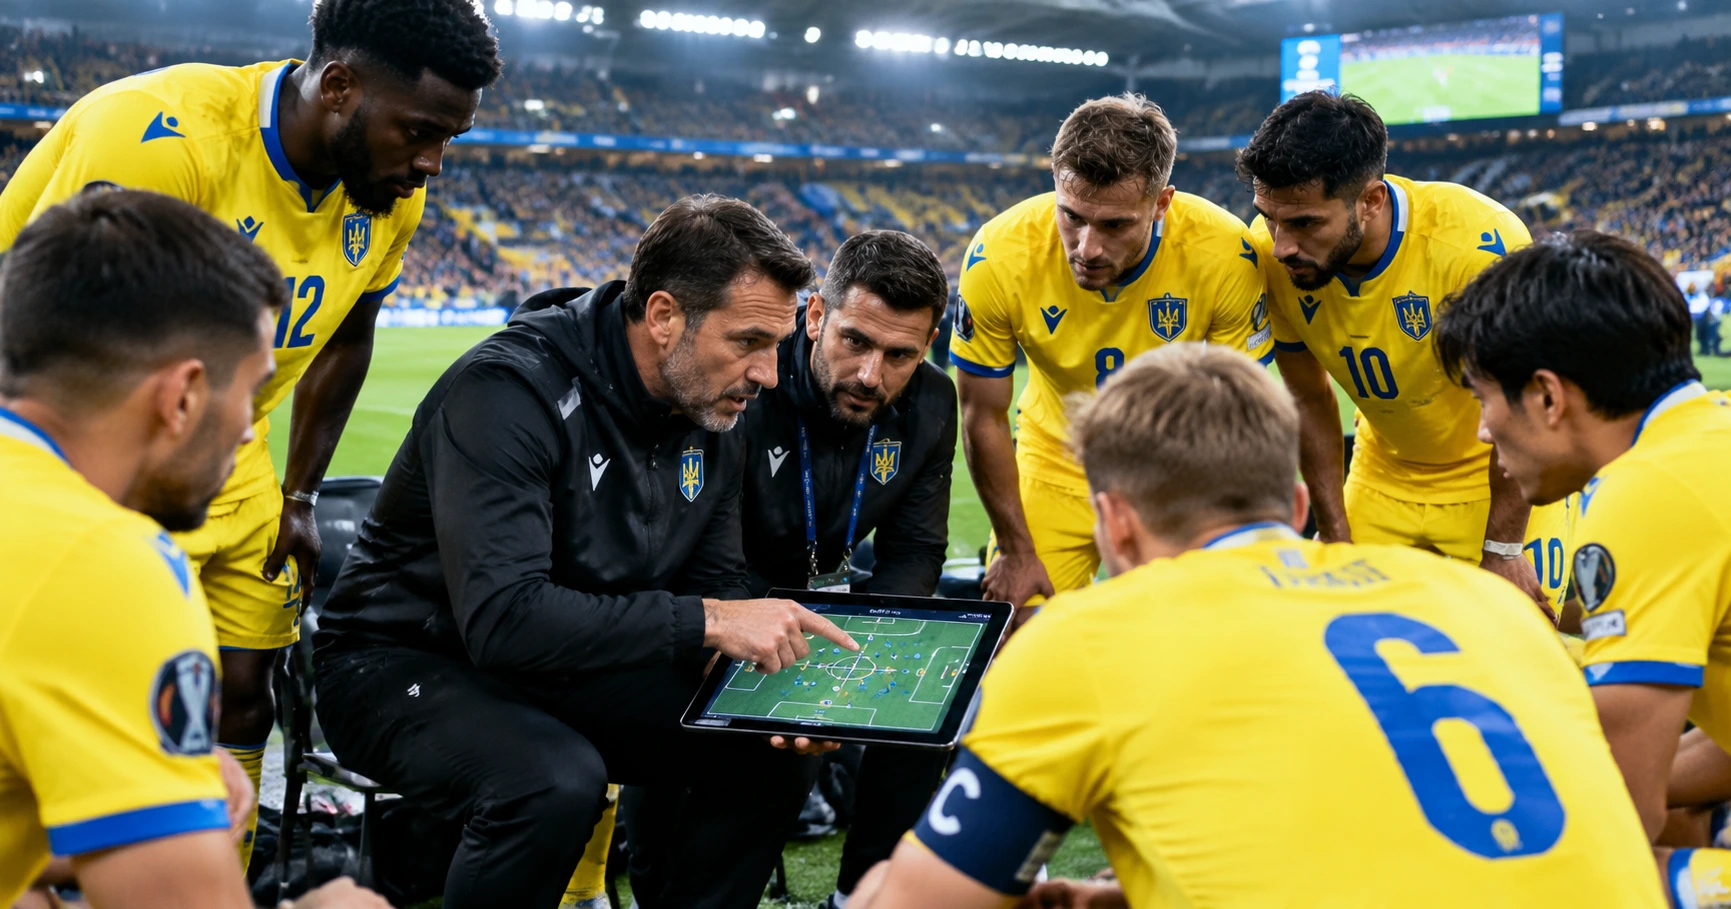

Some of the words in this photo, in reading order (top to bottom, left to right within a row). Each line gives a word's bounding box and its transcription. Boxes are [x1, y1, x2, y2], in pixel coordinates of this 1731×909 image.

[273, 275, 325, 348] 12
[1339, 346, 1399, 400] 10
[1523, 537, 1564, 589] 10
[1323, 611, 1567, 860] 6
[928, 767, 981, 836] C
